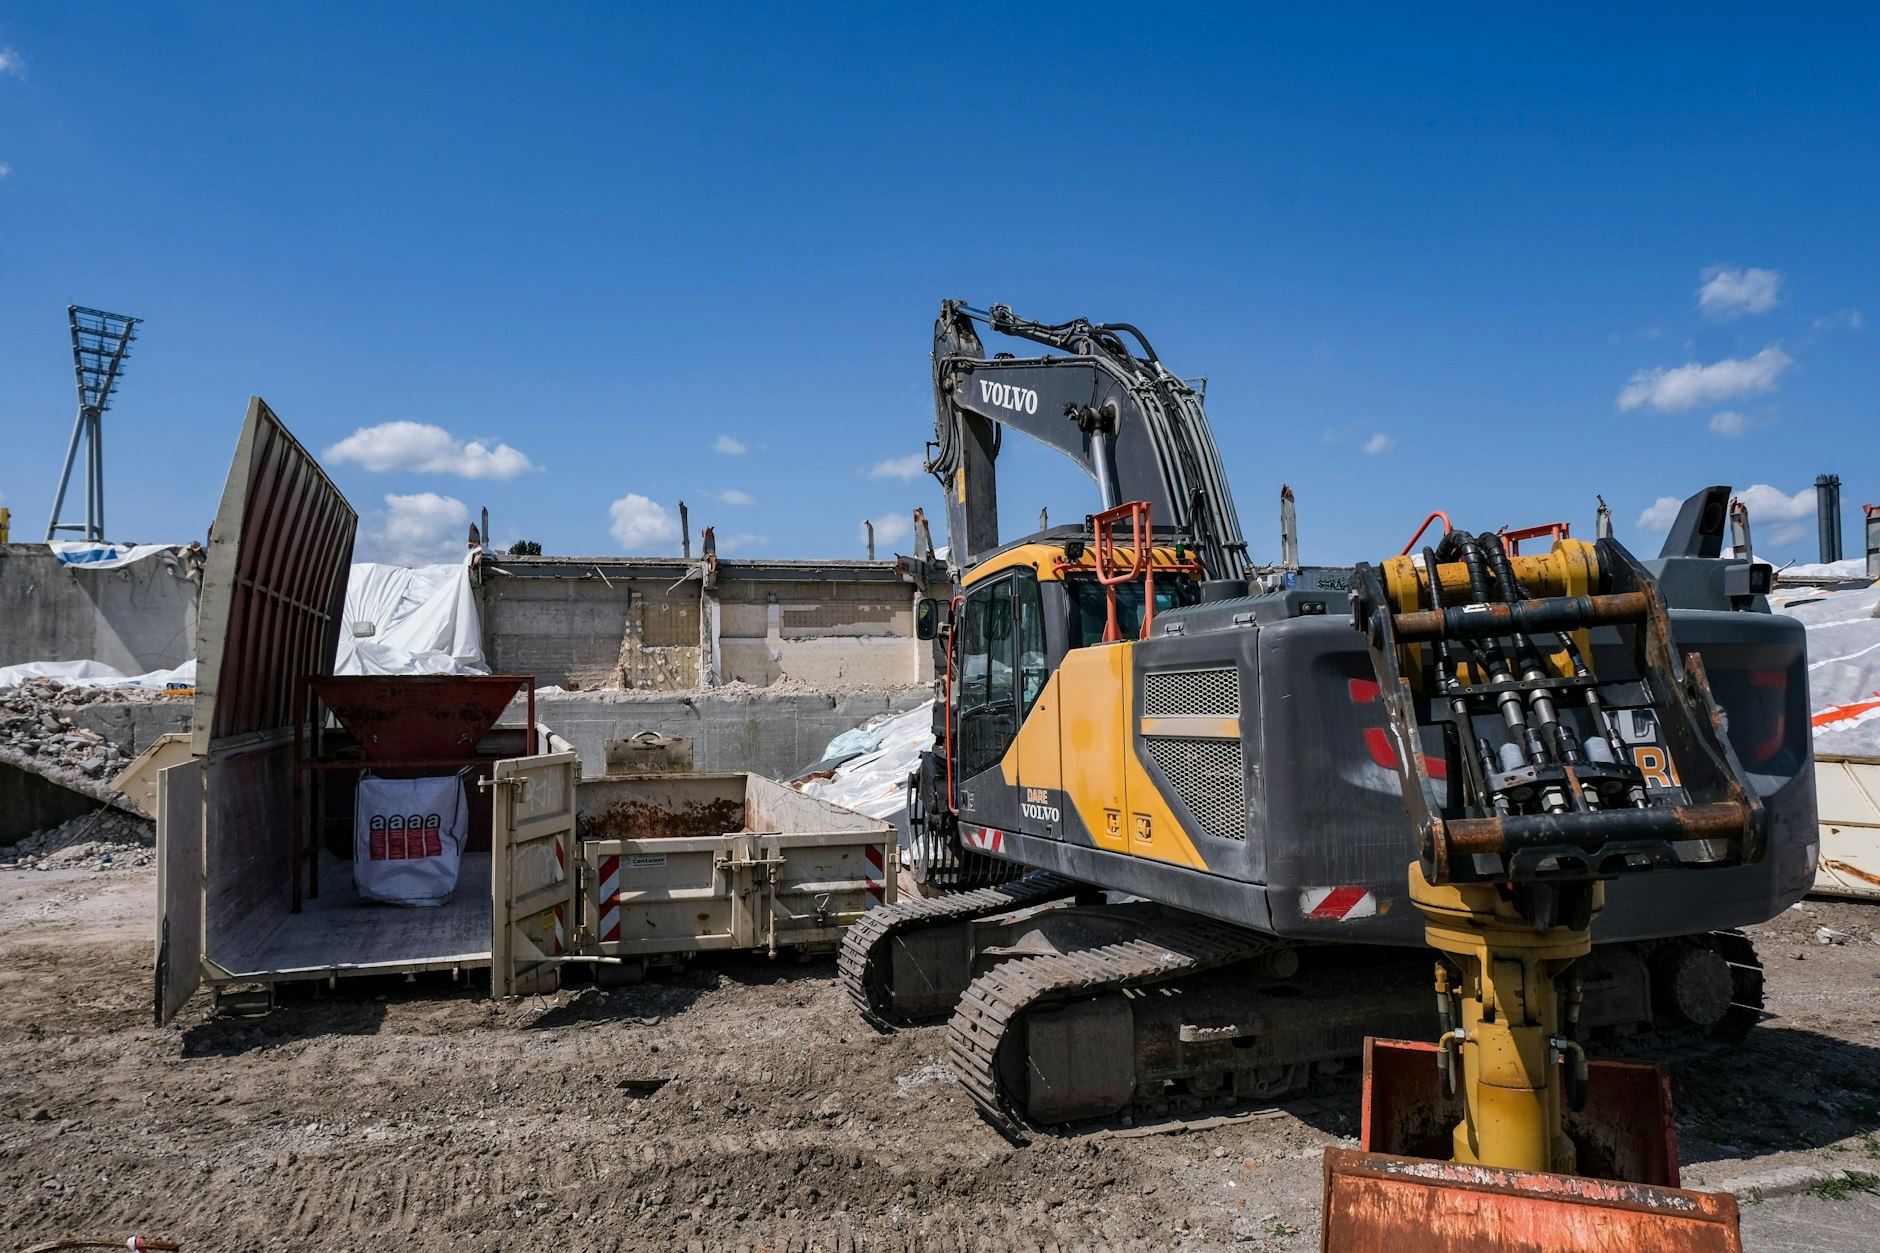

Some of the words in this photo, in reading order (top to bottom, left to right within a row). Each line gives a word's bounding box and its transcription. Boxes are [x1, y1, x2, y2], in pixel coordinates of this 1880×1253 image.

[979, 379, 1038, 415] VOLVO
[1026, 788, 1048, 805] DARE
[1020, 802, 1060, 822] VOLVO
